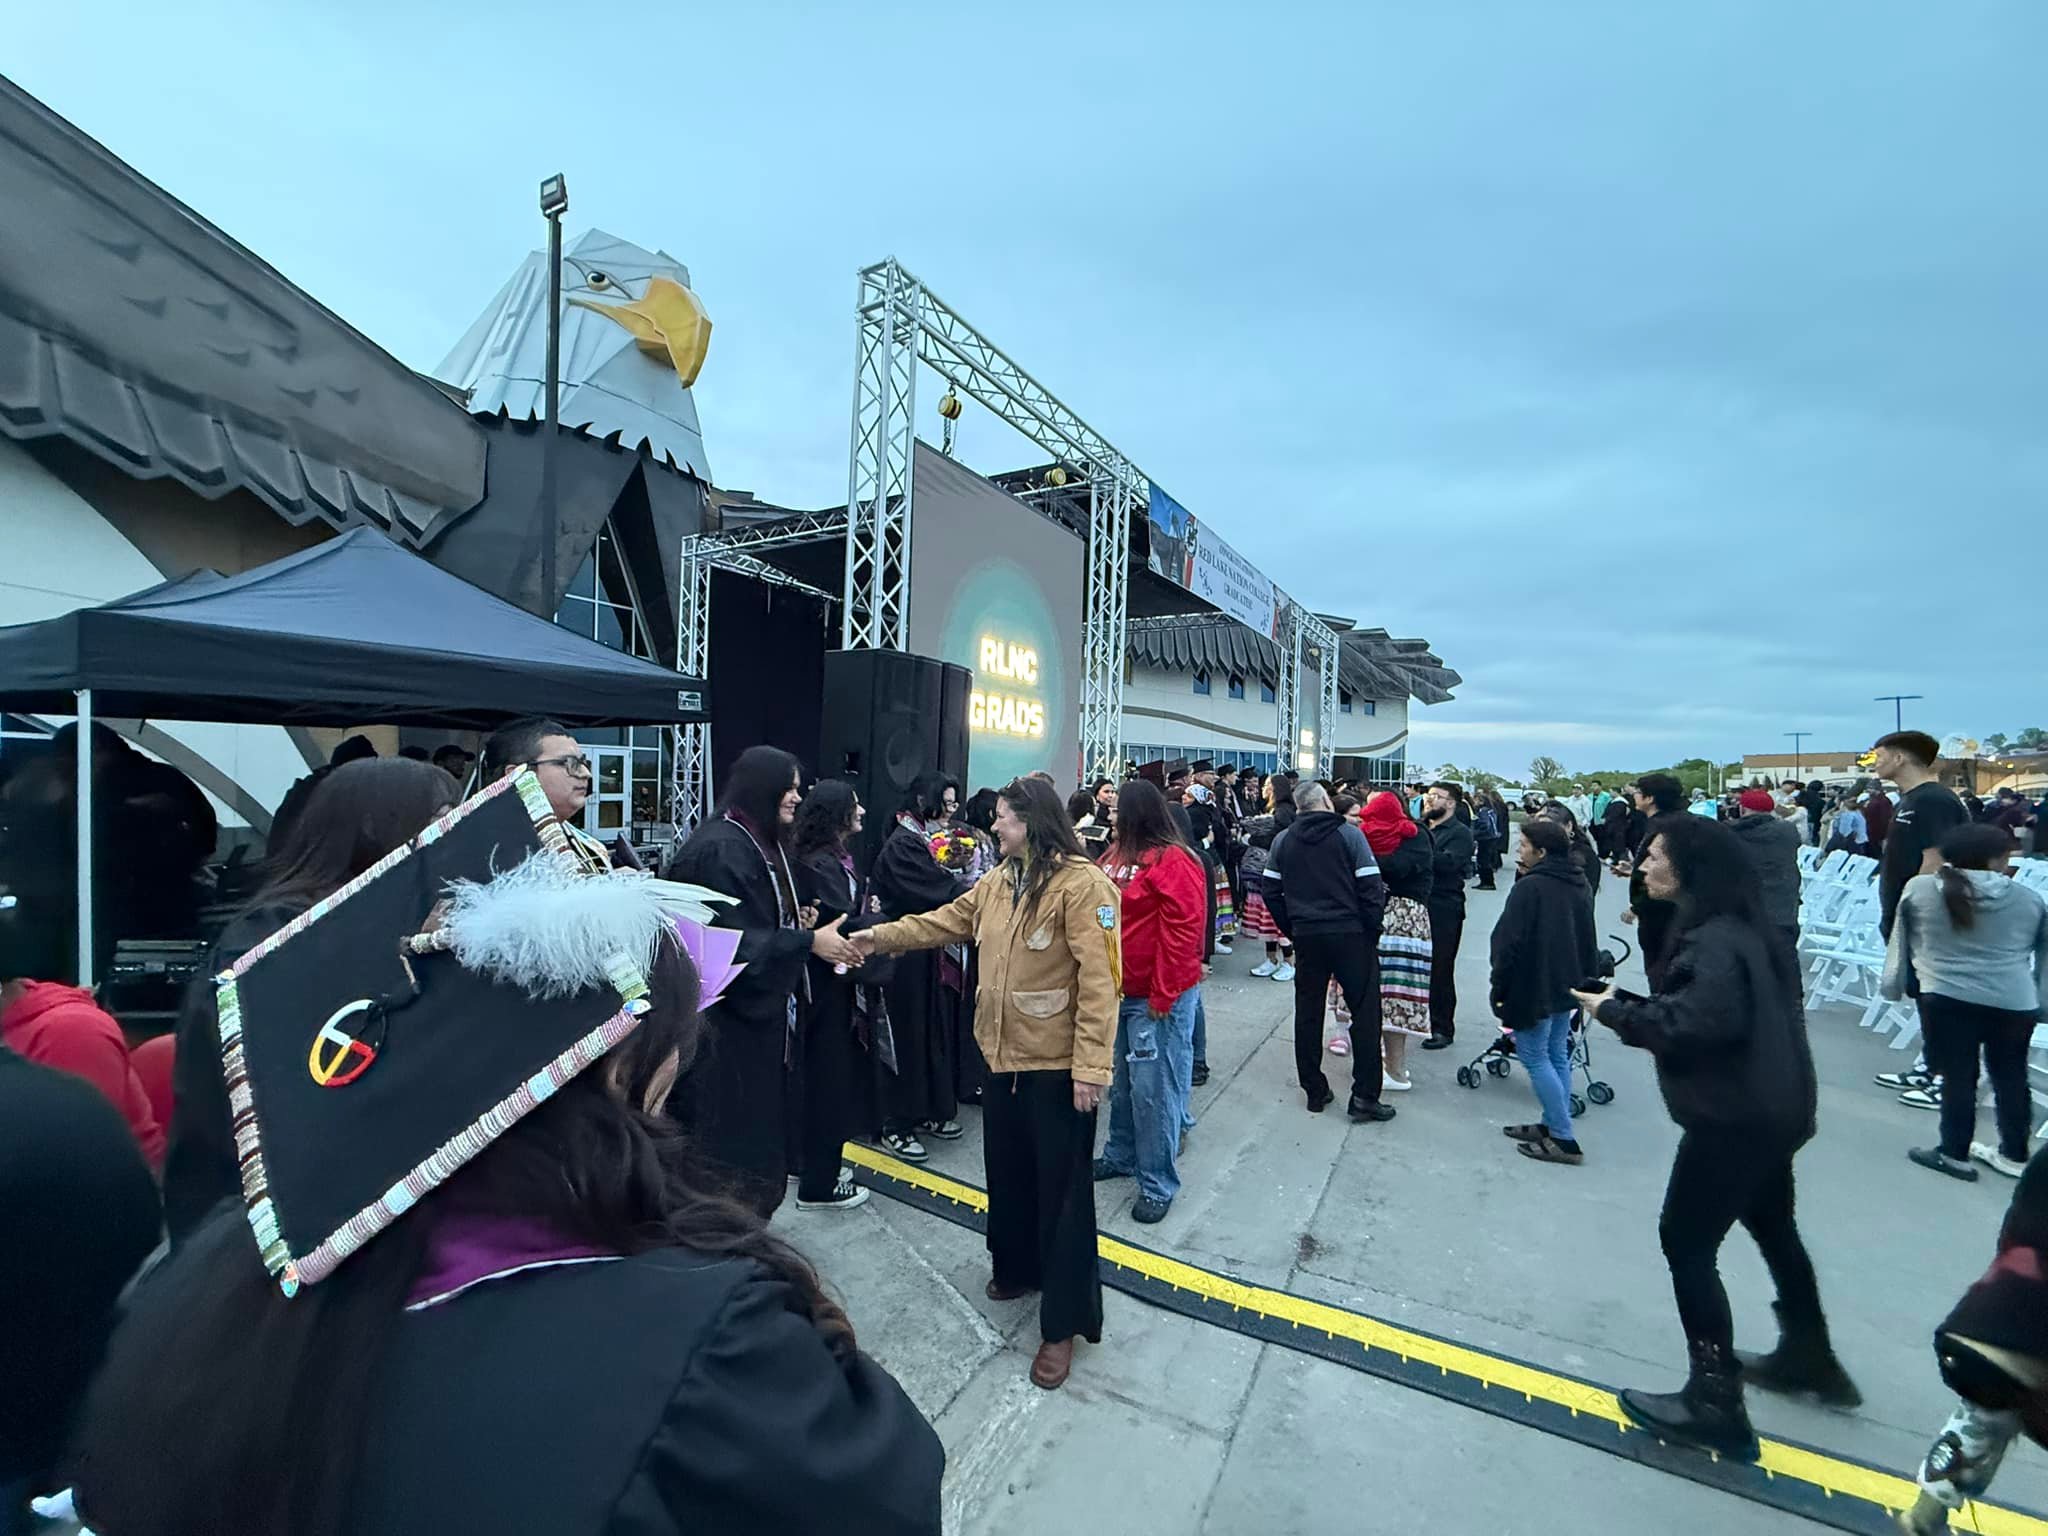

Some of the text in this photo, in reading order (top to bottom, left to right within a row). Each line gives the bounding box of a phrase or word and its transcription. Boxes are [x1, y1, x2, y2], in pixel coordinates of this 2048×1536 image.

[1199, 544, 1211, 564] RED
[980, 637, 1038, 684] RLNC
[968, 691, 1044, 736] GRADS
